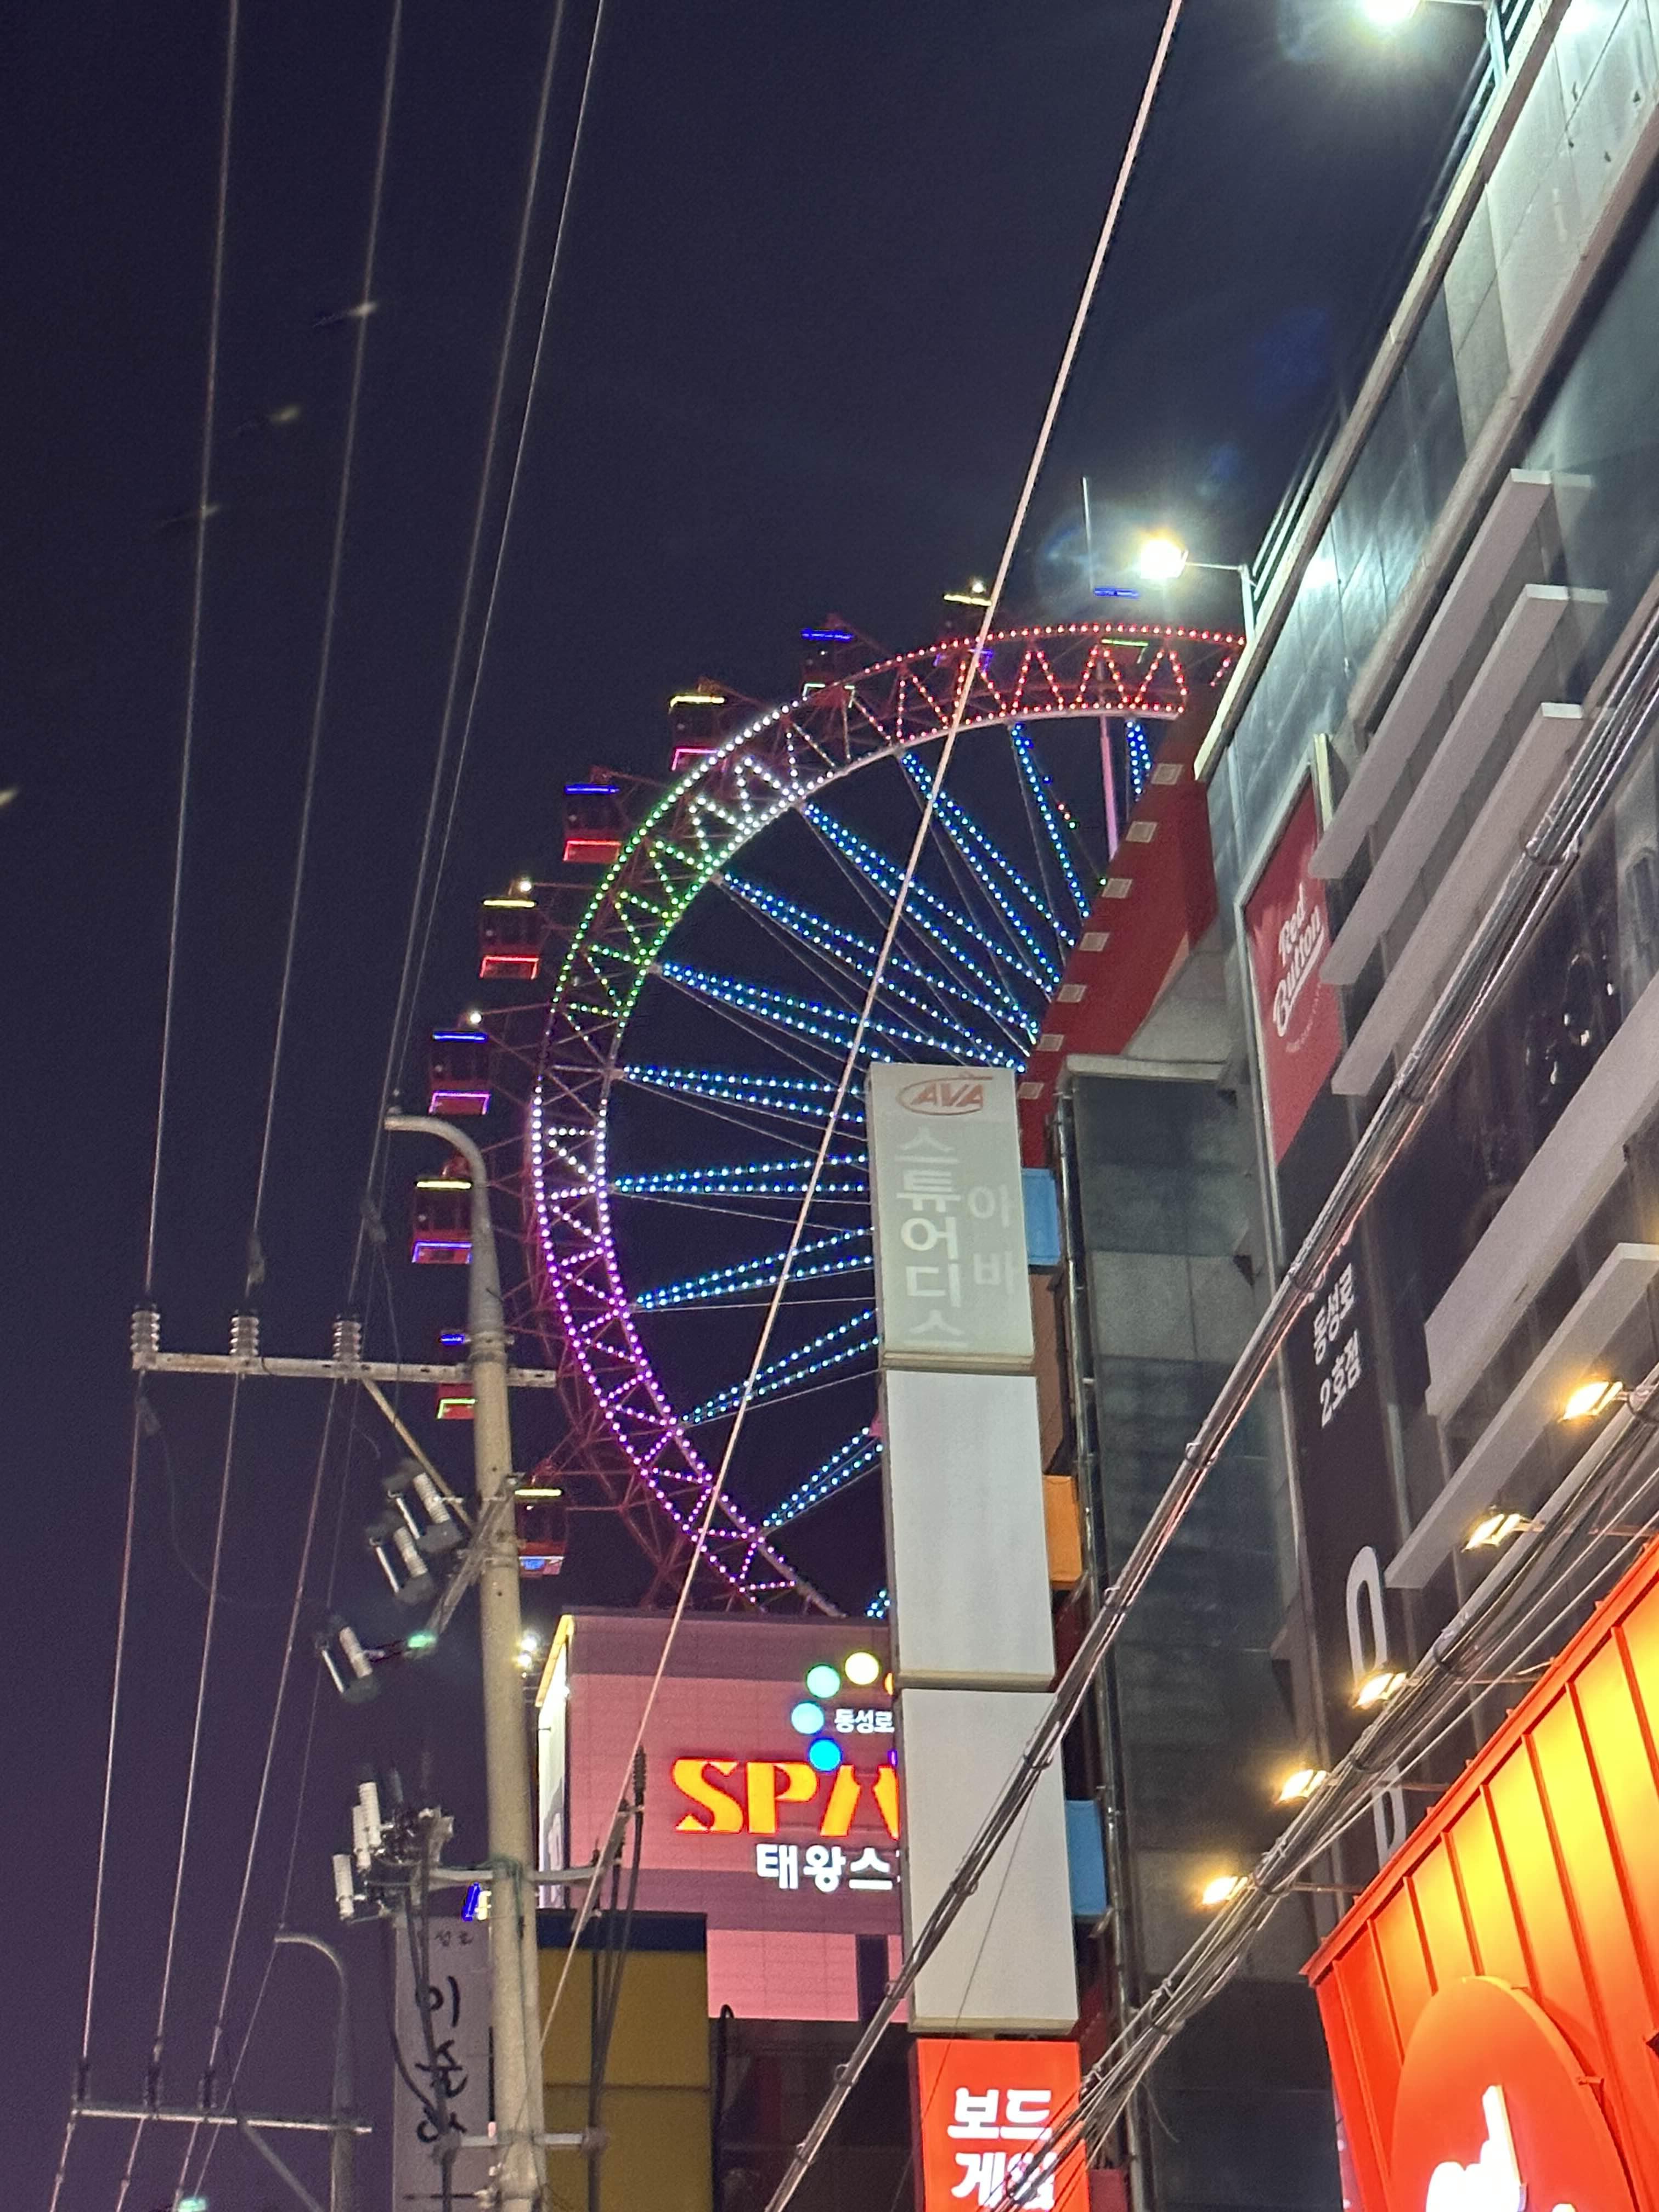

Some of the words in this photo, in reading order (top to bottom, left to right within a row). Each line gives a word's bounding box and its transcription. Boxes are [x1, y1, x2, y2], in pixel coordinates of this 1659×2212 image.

[911, 1082, 984, 1107] AVA
[895, 1126, 969, 1347] 스튜어디스
[1314, 1263, 1354, 1365] 동성로
[1320, 1329, 1362, 1427] 2호점
[834, 1709, 894, 1733] 동성로
[756, 1843, 900, 1892] 태왕스
[947, 2087, 1052, 2139] 보드
